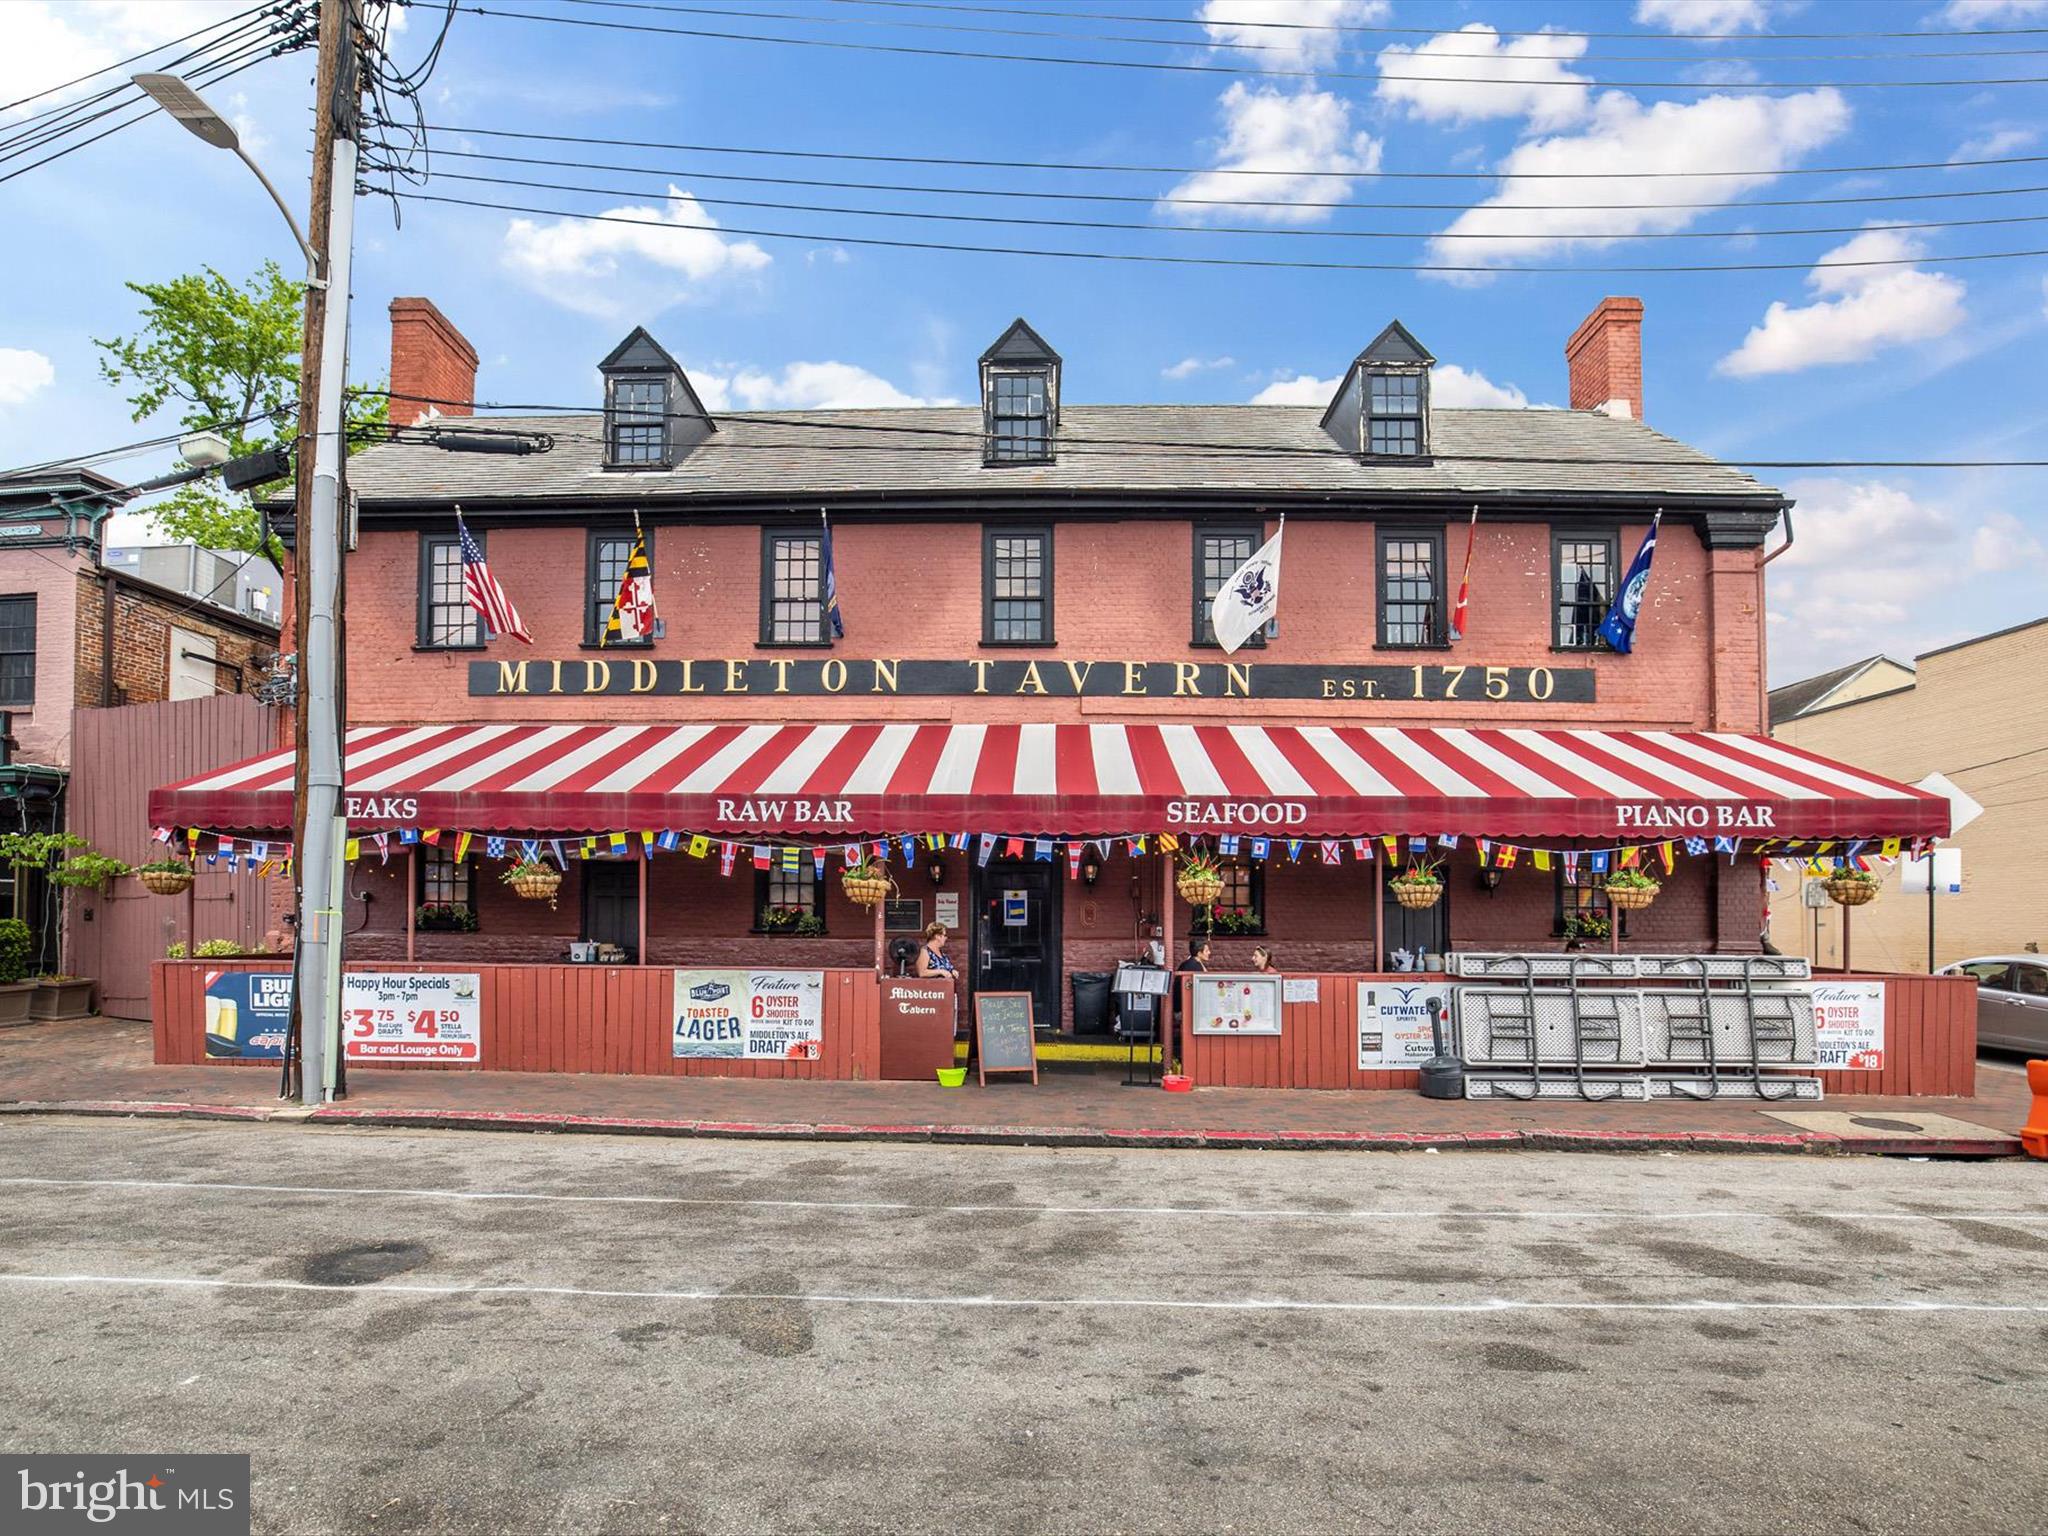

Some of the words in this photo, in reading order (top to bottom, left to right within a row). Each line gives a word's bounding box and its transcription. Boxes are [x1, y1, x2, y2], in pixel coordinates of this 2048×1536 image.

[497, 659, 902, 693] MIDDLETON
[969, 660, 1253, 697] TAVERN
[1322, 680, 1386, 698] EST.
[1411, 665, 1554, 700] 1750
[344, 798, 417, 819] EAKS
[717, 800, 787, 823] RAW
[794, 801, 854, 823] BAR
[1167, 802, 1307, 824] SEAFOOD
[1616, 805, 1710, 827] PIANO
[1716, 806, 1776, 827] BAR
[347, 976, 380, 991] Happy
[382, 977, 407, 989] Hour
[409, 977, 450, 991] Specials
[751, 976, 801, 992] Feature
[378, 991, 395, 1001] 3pm
[401, 991, 418, 1001] 7pm
[889, 987, 945, 999] Middleton
[1813, 987, 1861, 1002] Feature
[752, 996, 764, 1018] 6
[766, 996, 799, 1007] OYSTER
[898, 1002, 936, 1014] Tavern
[687, 1008, 729, 1018] TOASTED
[766, 1010, 799, 1018] SHOOTERS
[1828, 1007, 1859, 1018] OYSTER
[676, 1016, 742, 1041] LAGER
[1828, 1020, 1859, 1028] SHOOTERS
[750, 1031, 796, 1039] MIDDLETON'S
[360, 1044, 377, 1054] Bar
[380, 1044, 399, 1054] and
[401, 1044, 437, 1056] Lounge
[439, 1044, 463, 1056] Only
[750, 1040, 787, 1053] DRAFT
[1857, 1041, 1870, 1049] ALE
[1820, 1050, 1847, 1063] RAFT
[1859, 1053, 1878, 1068] $18
